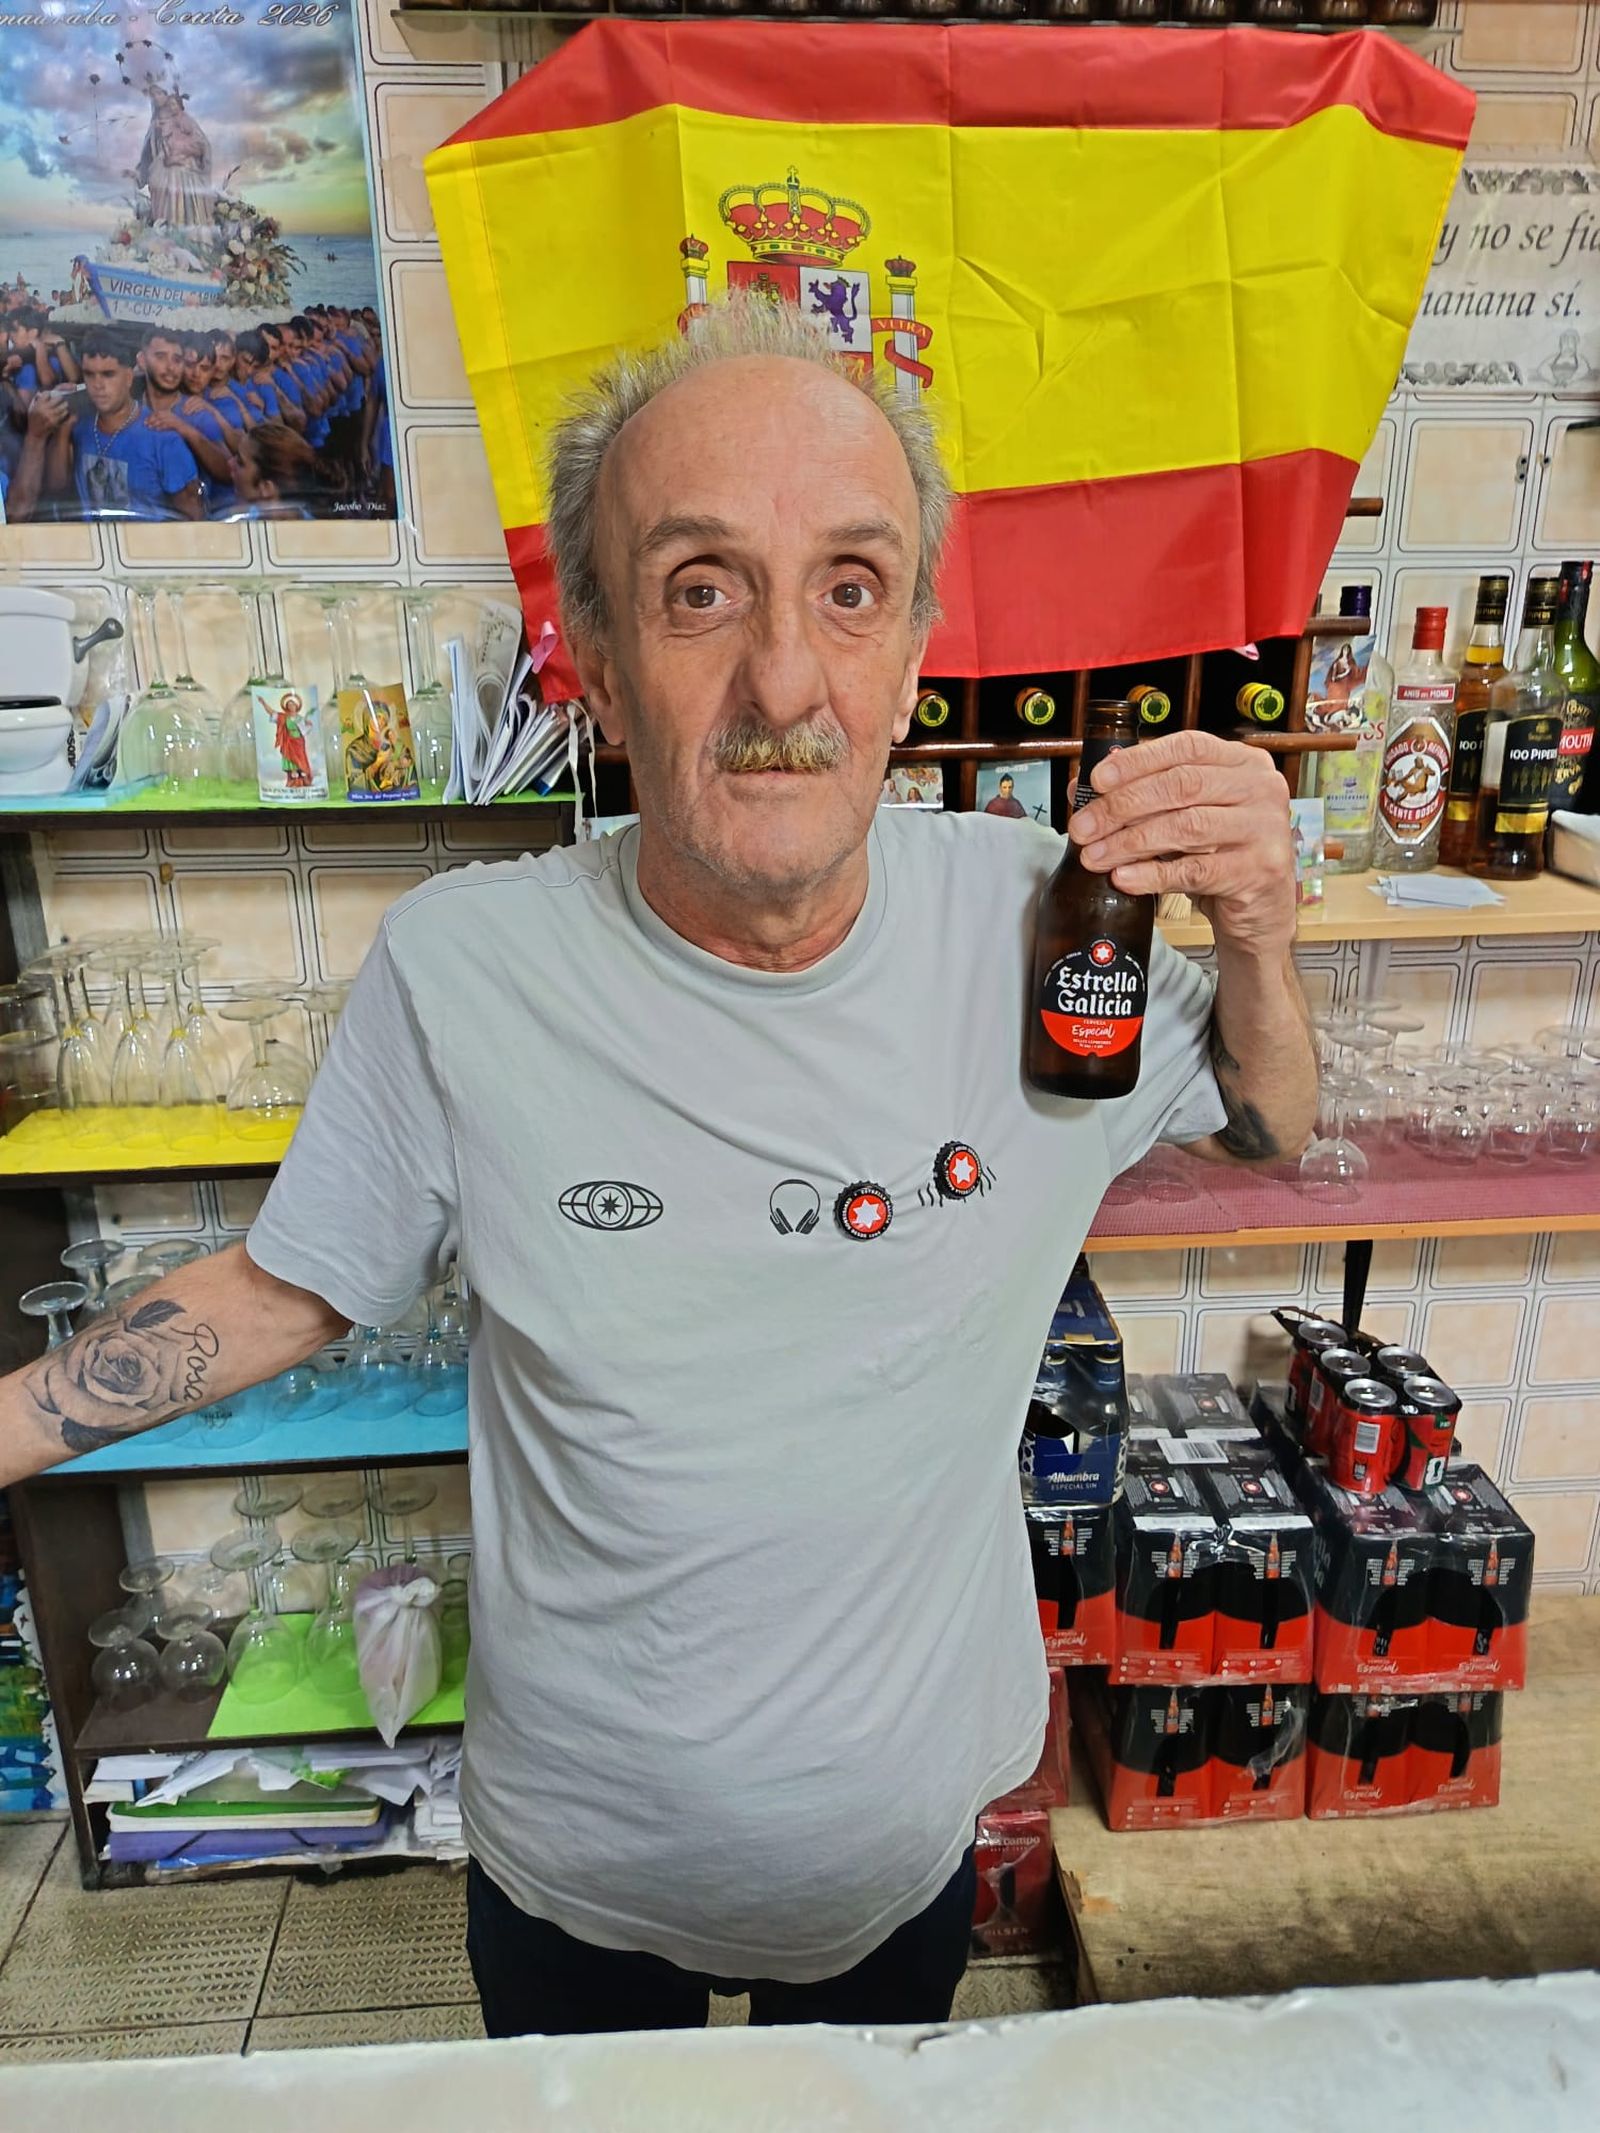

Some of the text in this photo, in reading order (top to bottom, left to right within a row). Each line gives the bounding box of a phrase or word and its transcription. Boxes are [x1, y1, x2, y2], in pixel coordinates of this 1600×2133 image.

[257, 3, 339, 26] 2026
[1469, 222, 1511, 251] no
[1518, 223, 1554, 251] se
[110, 279, 161, 300] VIRGEN
[1459, 740, 1478, 751] 100
[1510, 748, 1529, 761] 100
[1056, 966, 1138, 993] Estrella
[1057, 989, 1132, 1016] Galicia
[1071, 1023, 1116, 1039] Especial
[169, 1323, 219, 1401] Rosa
[1047, 1471, 1100, 1483] Alhambra
[1356, 1658, 1399, 1675] Especial
